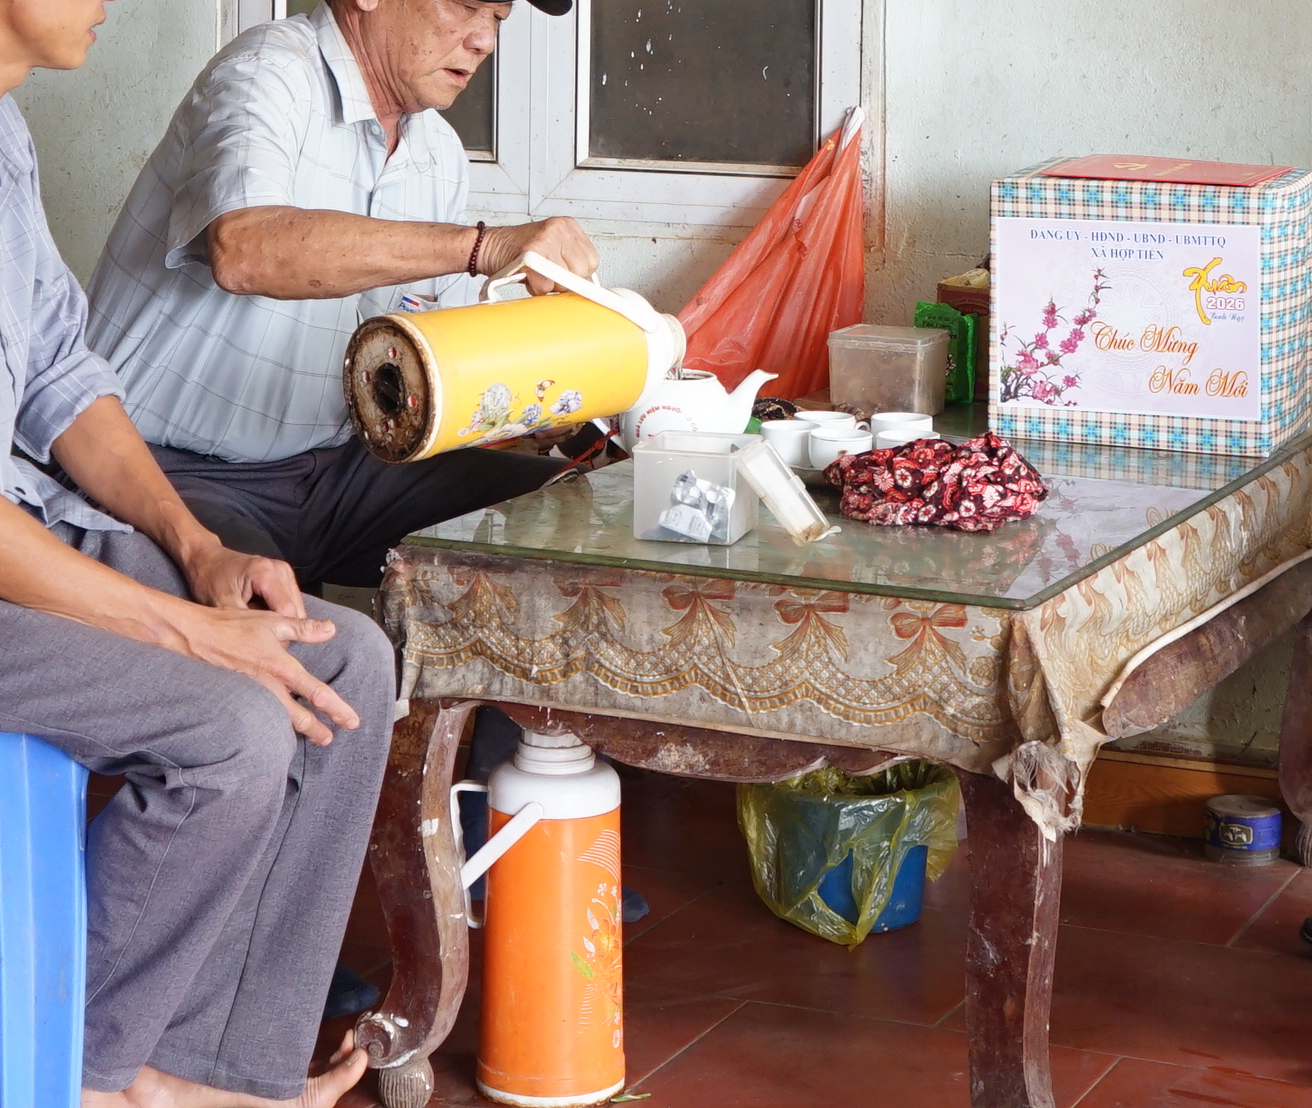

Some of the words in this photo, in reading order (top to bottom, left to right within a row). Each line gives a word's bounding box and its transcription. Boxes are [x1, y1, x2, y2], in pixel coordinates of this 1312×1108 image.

[1030, 226, 1063, 240] ĐẢNG
[1091, 231, 1124, 242] HĐND
[1134, 233, 1166, 244] UBND
[1175, 234, 1226, 249] UBMTTQ
[1091, 245, 1107, 258] XÃ
[1110, 248, 1135, 261] HỢP
[1183, 257, 1248, 325] Xuân
[1206, 296, 1246, 311] 2026
[1090, 321, 1136, 351] Chúc
[1139, 323, 1200, 366] Mừng
[1148, 364, 1201, 395] Năm
[1205, 367, 1249, 398] Mới
